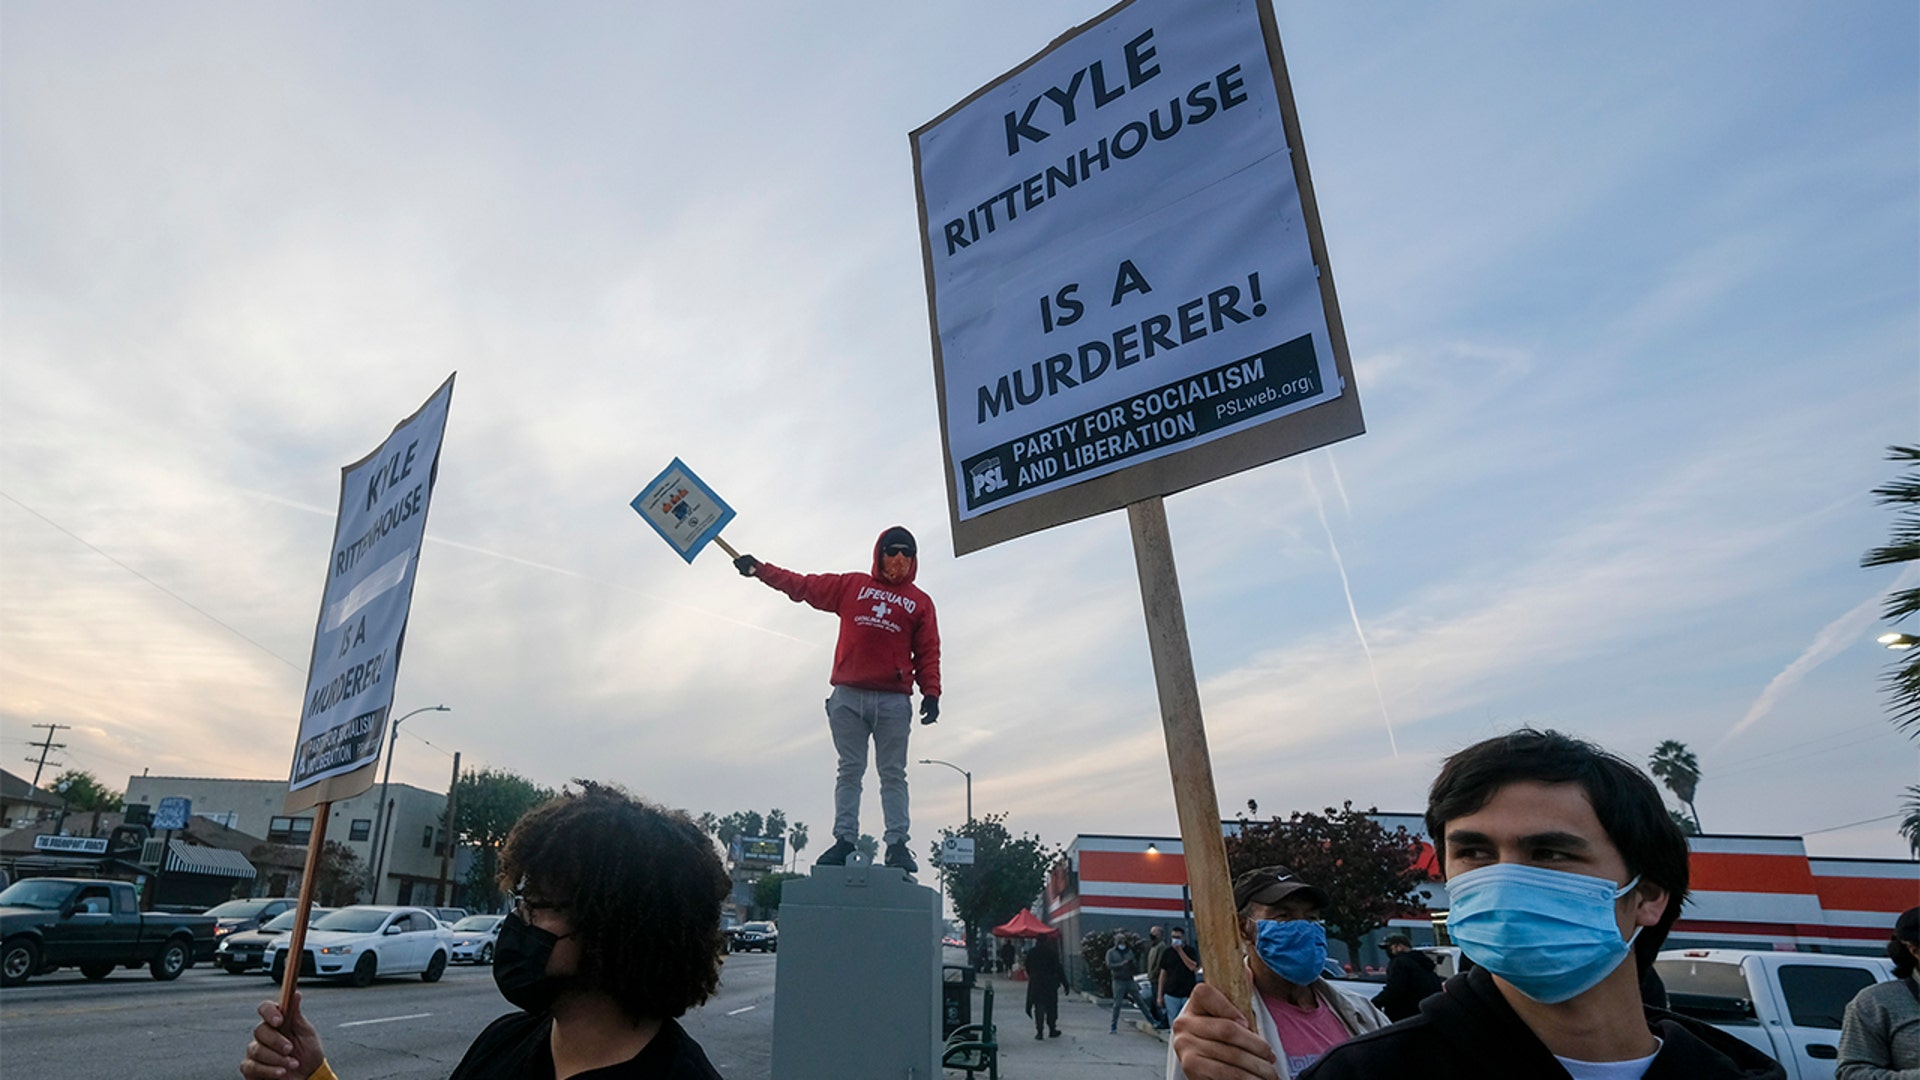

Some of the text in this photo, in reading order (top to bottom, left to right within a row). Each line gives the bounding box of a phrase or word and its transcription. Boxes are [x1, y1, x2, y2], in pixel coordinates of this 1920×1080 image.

[1004, 27, 1162, 157] KYLE
[943, 63, 1249, 257] RITTENHOUSE
[1039, 259, 1153, 334] IS A
[976, 271, 1268, 424] MURDERER!
[1012, 357, 1266, 462] PARTY FOR SOCIALISM
[1215, 376, 1309, 420] PSLweb.org
[366, 438, 419, 512] KYLE
[972, 465, 1009, 499] PSL
[1017, 410, 1197, 487] AND LIBERATION
[335, 482, 423, 578] RITTENHOUSE
[338, 615, 366, 659] IS A
[857, 586, 917, 614] LIFEGUARD
[308, 647, 388, 719] MURDERER!
